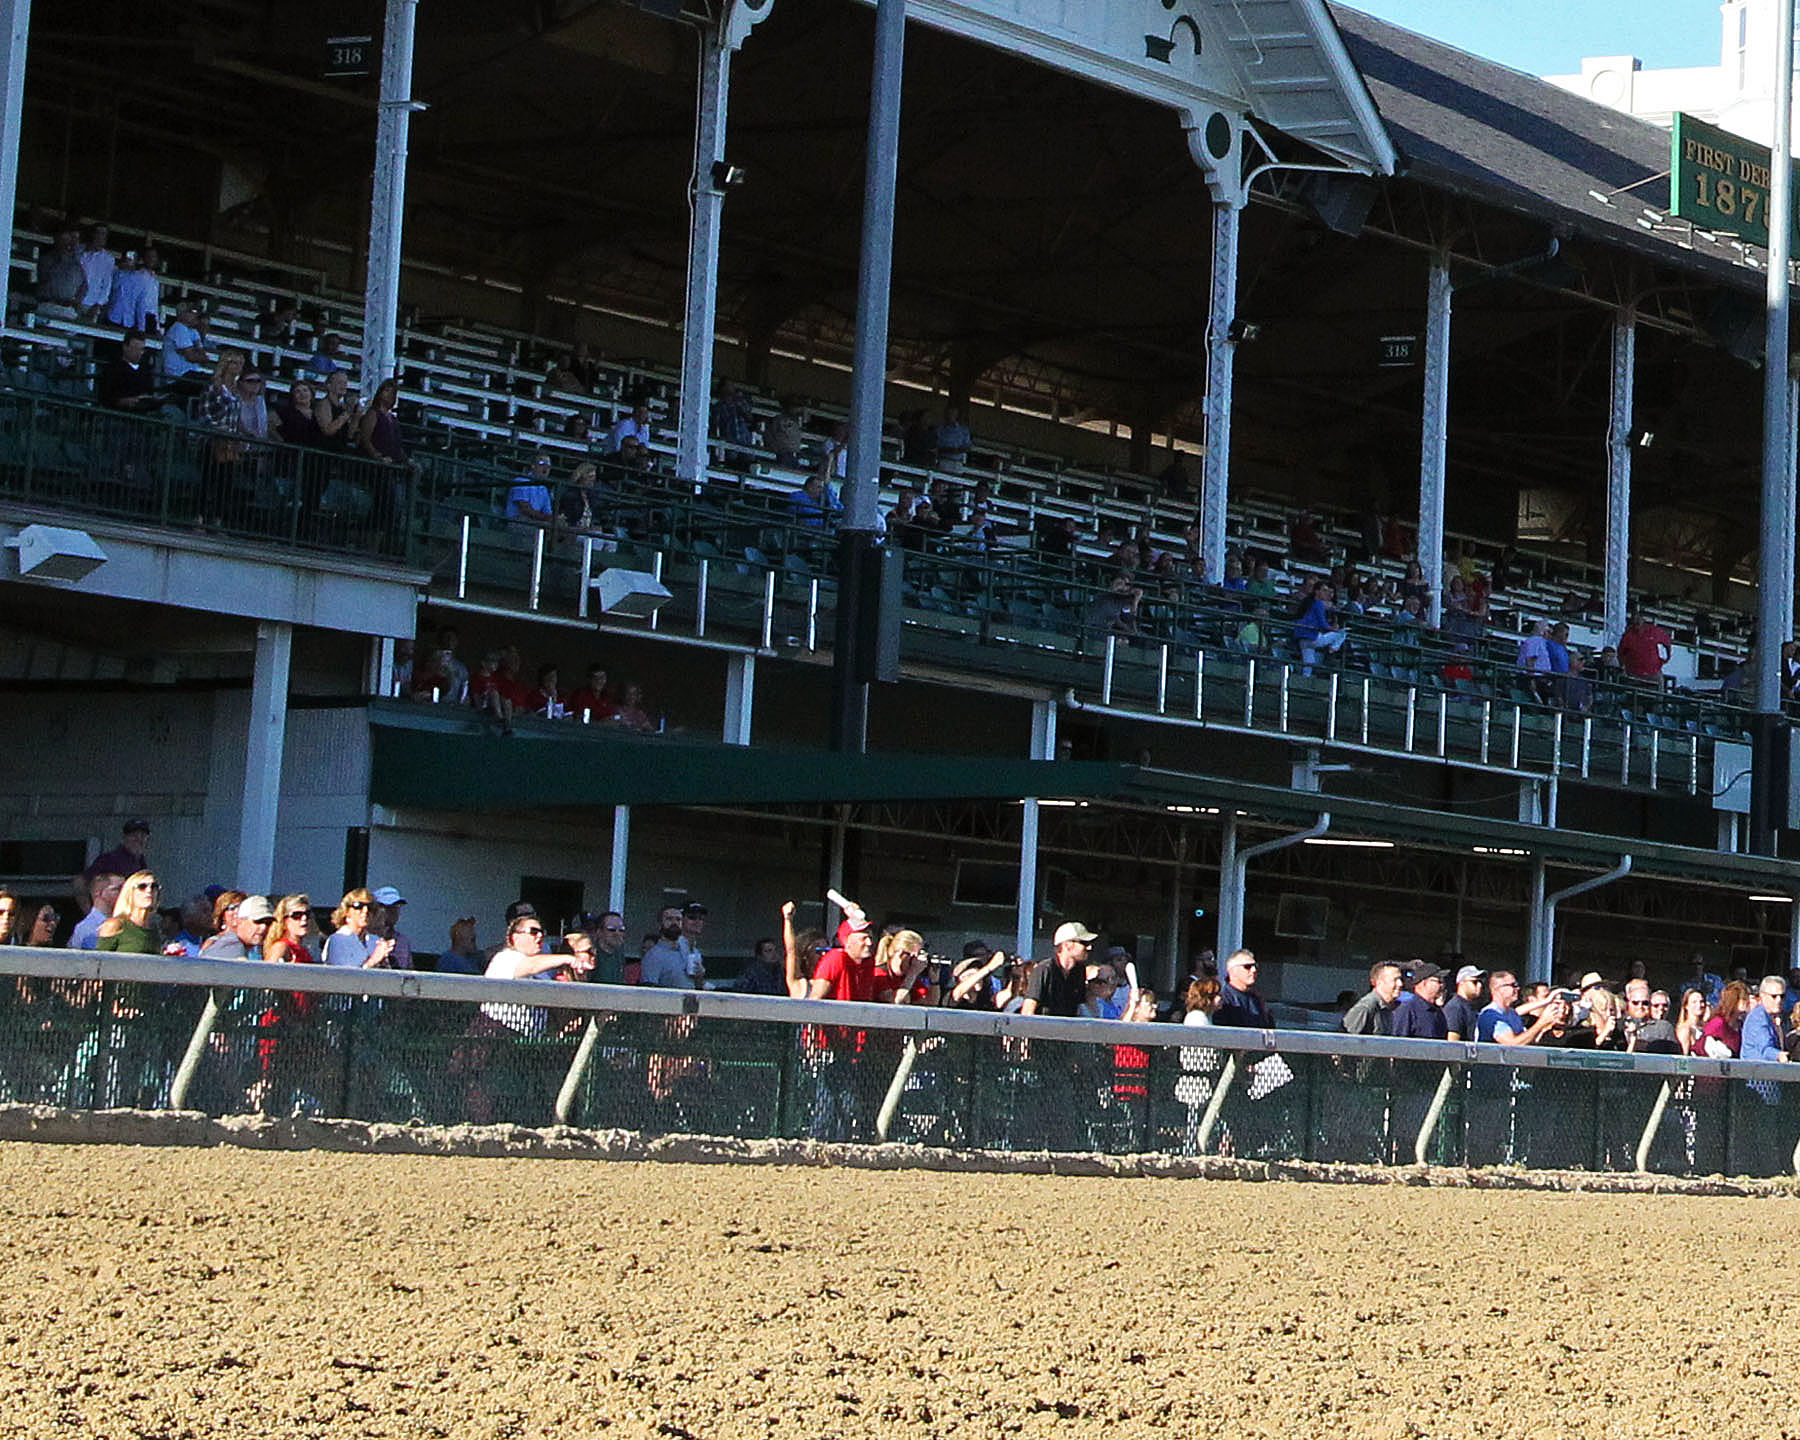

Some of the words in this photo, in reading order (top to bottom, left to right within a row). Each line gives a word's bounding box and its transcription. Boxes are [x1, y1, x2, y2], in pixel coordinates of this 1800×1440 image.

[333, 47, 362, 64] 318
[1685, 138, 1735, 176] FIRST
[1739, 159, 1770, 190] DER
[1385, 344, 1409, 358] 318
